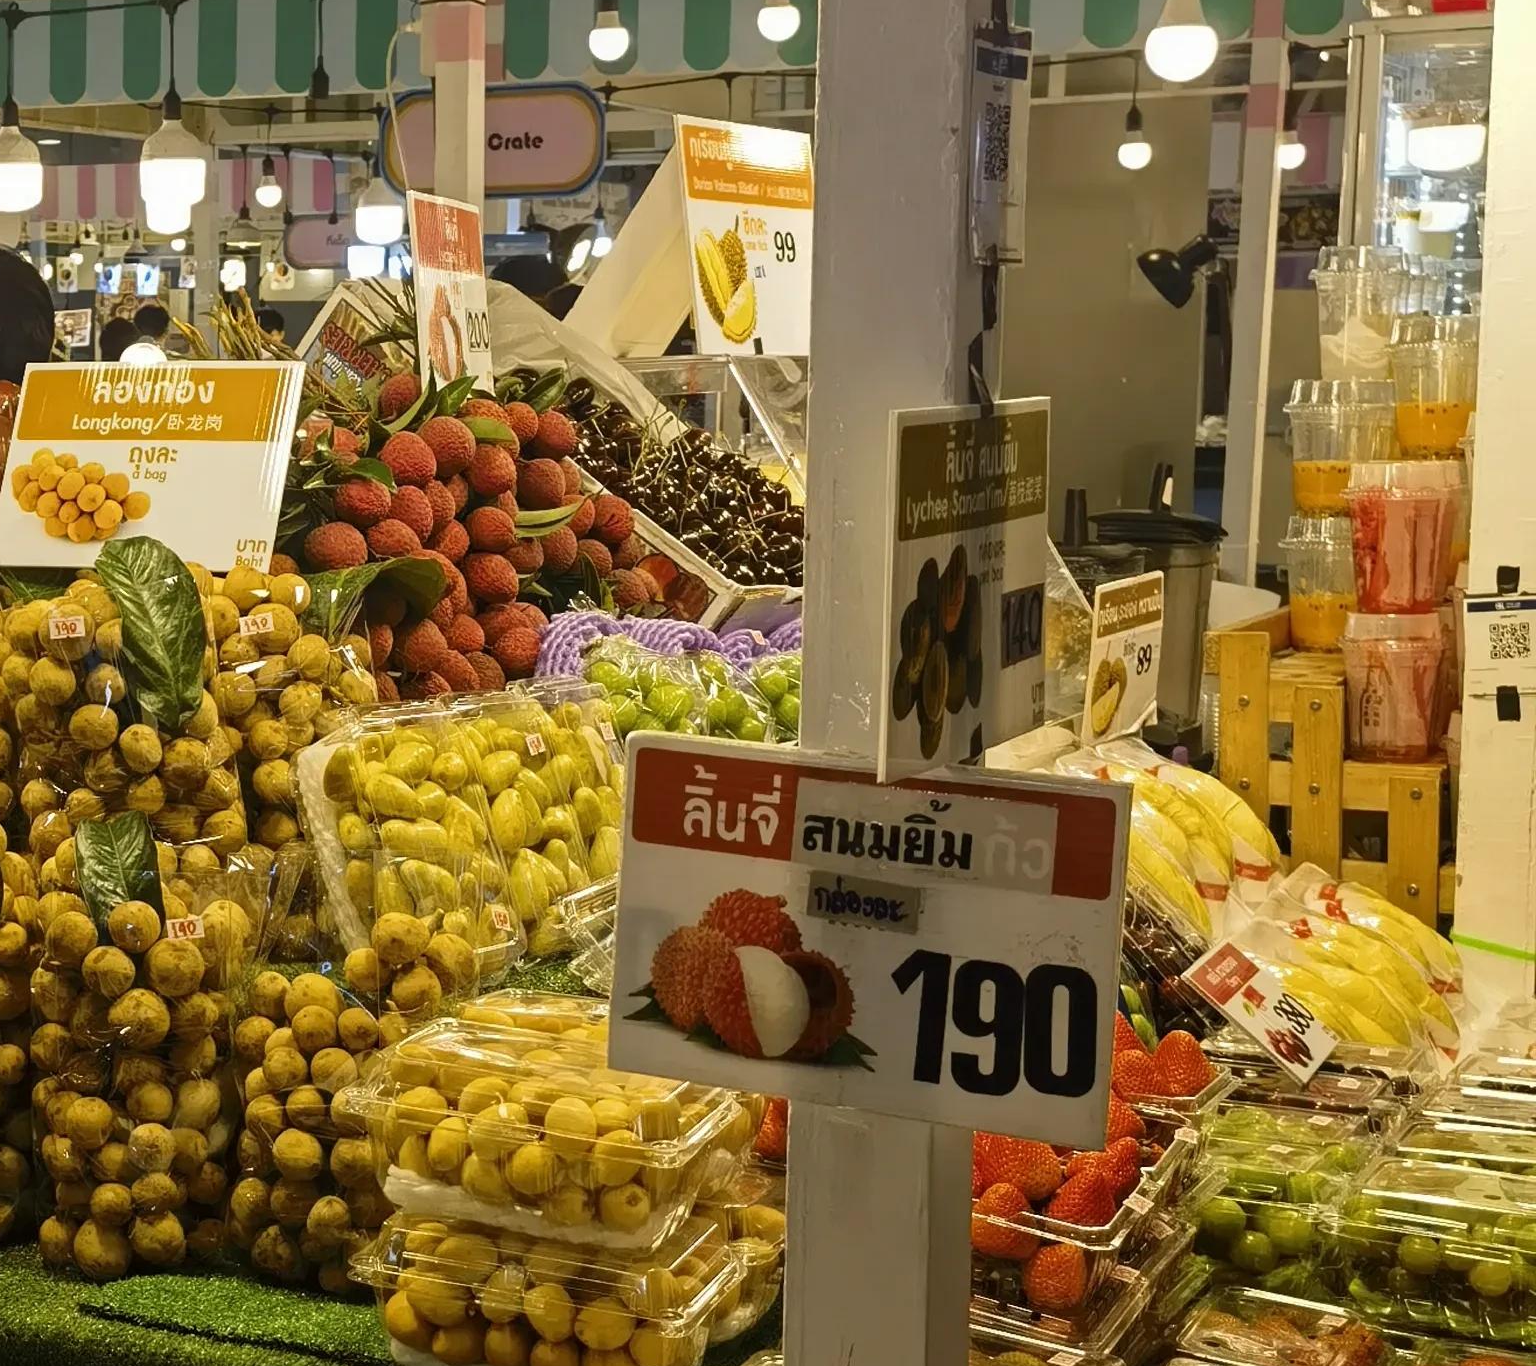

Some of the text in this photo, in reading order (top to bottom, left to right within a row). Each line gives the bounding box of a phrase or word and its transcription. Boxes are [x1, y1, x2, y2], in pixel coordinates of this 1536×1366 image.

[487, 131, 545, 151] Crate
[773, 230, 797, 264] 99
[92, 379, 215, 405] ลองกอง
[128, 445, 179, 472] ถุงละ
[143, 468, 168, 483] bag
[906, 489, 949, 534] Lychee
[236, 538, 268, 554] บาท
[235, 554, 264, 567] Baht
[1136, 643, 1153, 676] 89
[683, 764, 784, 848] ลิ้นจี่
[801, 798, 973, 872] สนมยิ้ม
[891, 948, 1098, 1098] 190
